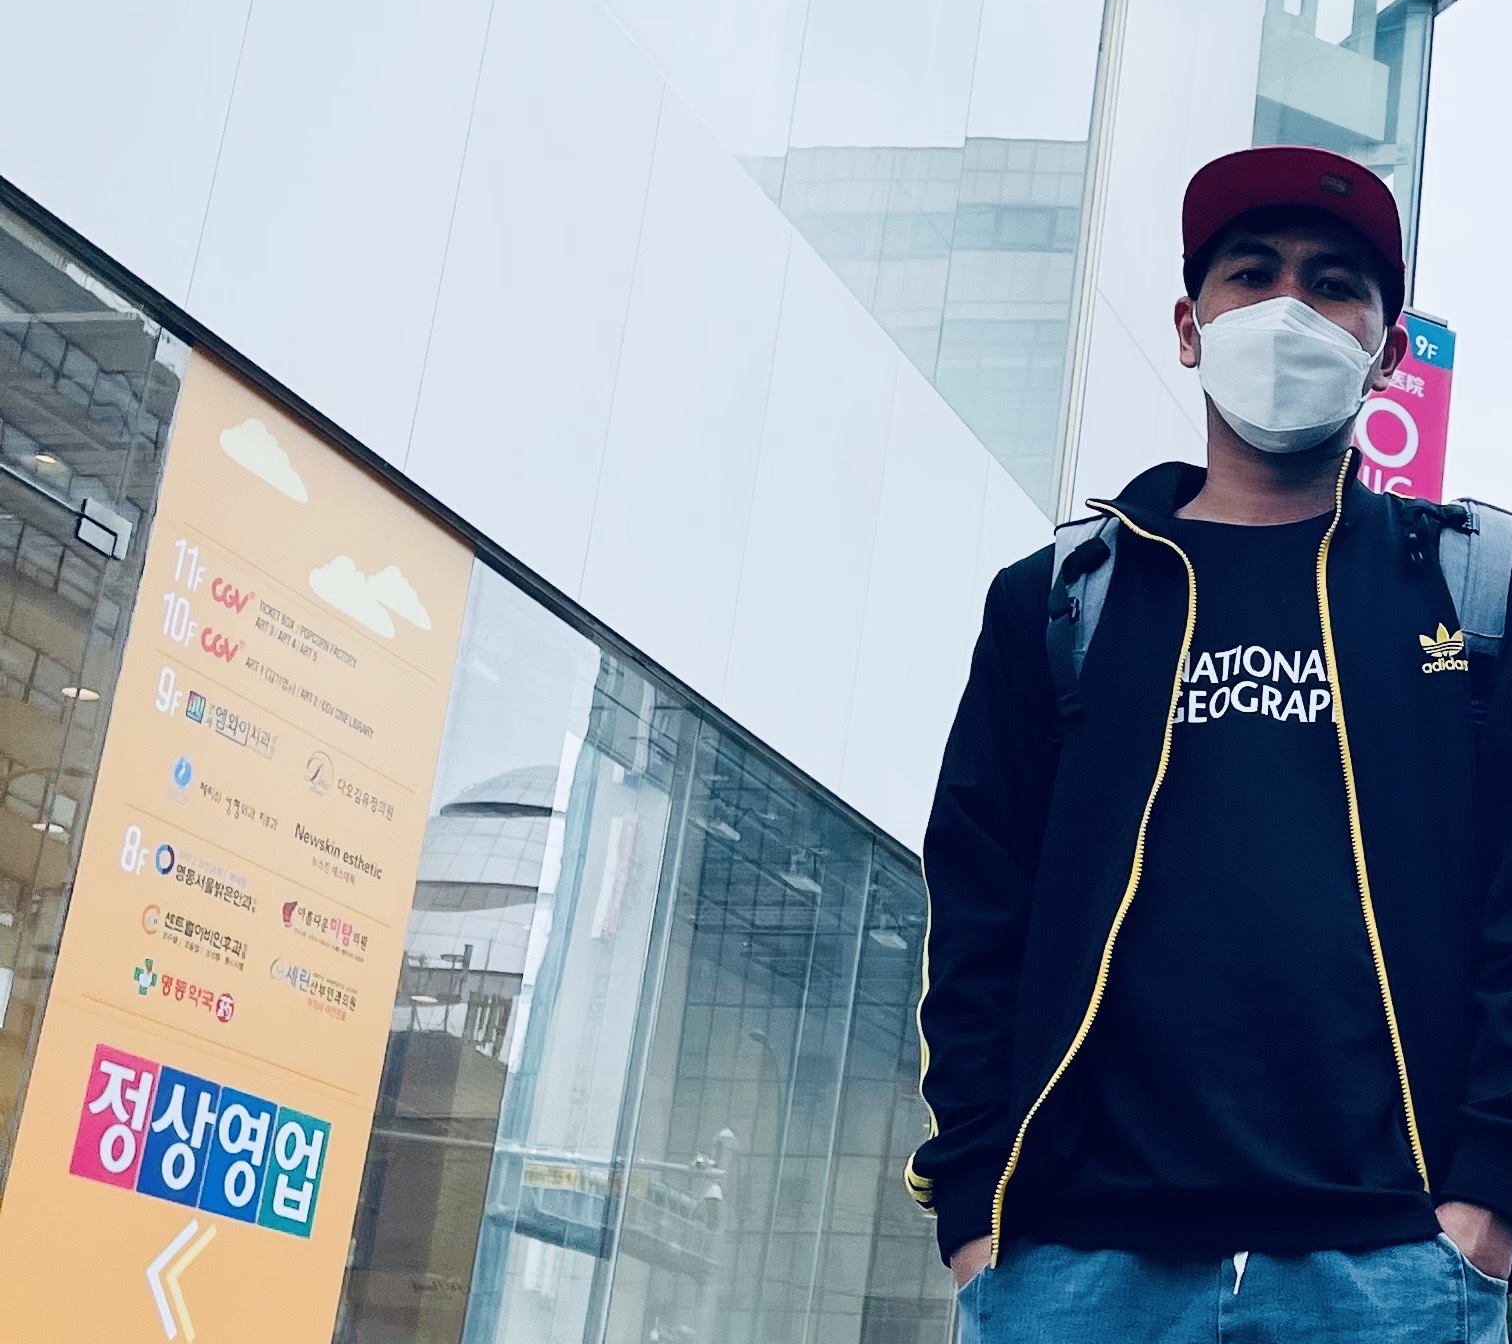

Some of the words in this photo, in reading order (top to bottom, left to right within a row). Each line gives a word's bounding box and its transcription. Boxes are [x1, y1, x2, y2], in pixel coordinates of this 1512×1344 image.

[1415, 335, 1438, 360] 9F
[211, 577, 249, 615] CGV
[200, 626, 239, 664] CGV
[329, 642, 358, 669] FACTORY
[1180, 644, 1331, 684] ATIONA
[1422, 656, 1469, 674] adidas
[294, 822, 341, 859] Newskin
[342, 851, 383, 880] esthetic
[161, 973, 215, 1013] 명동약국
[88, 1059, 325, 1224] 정상영업
